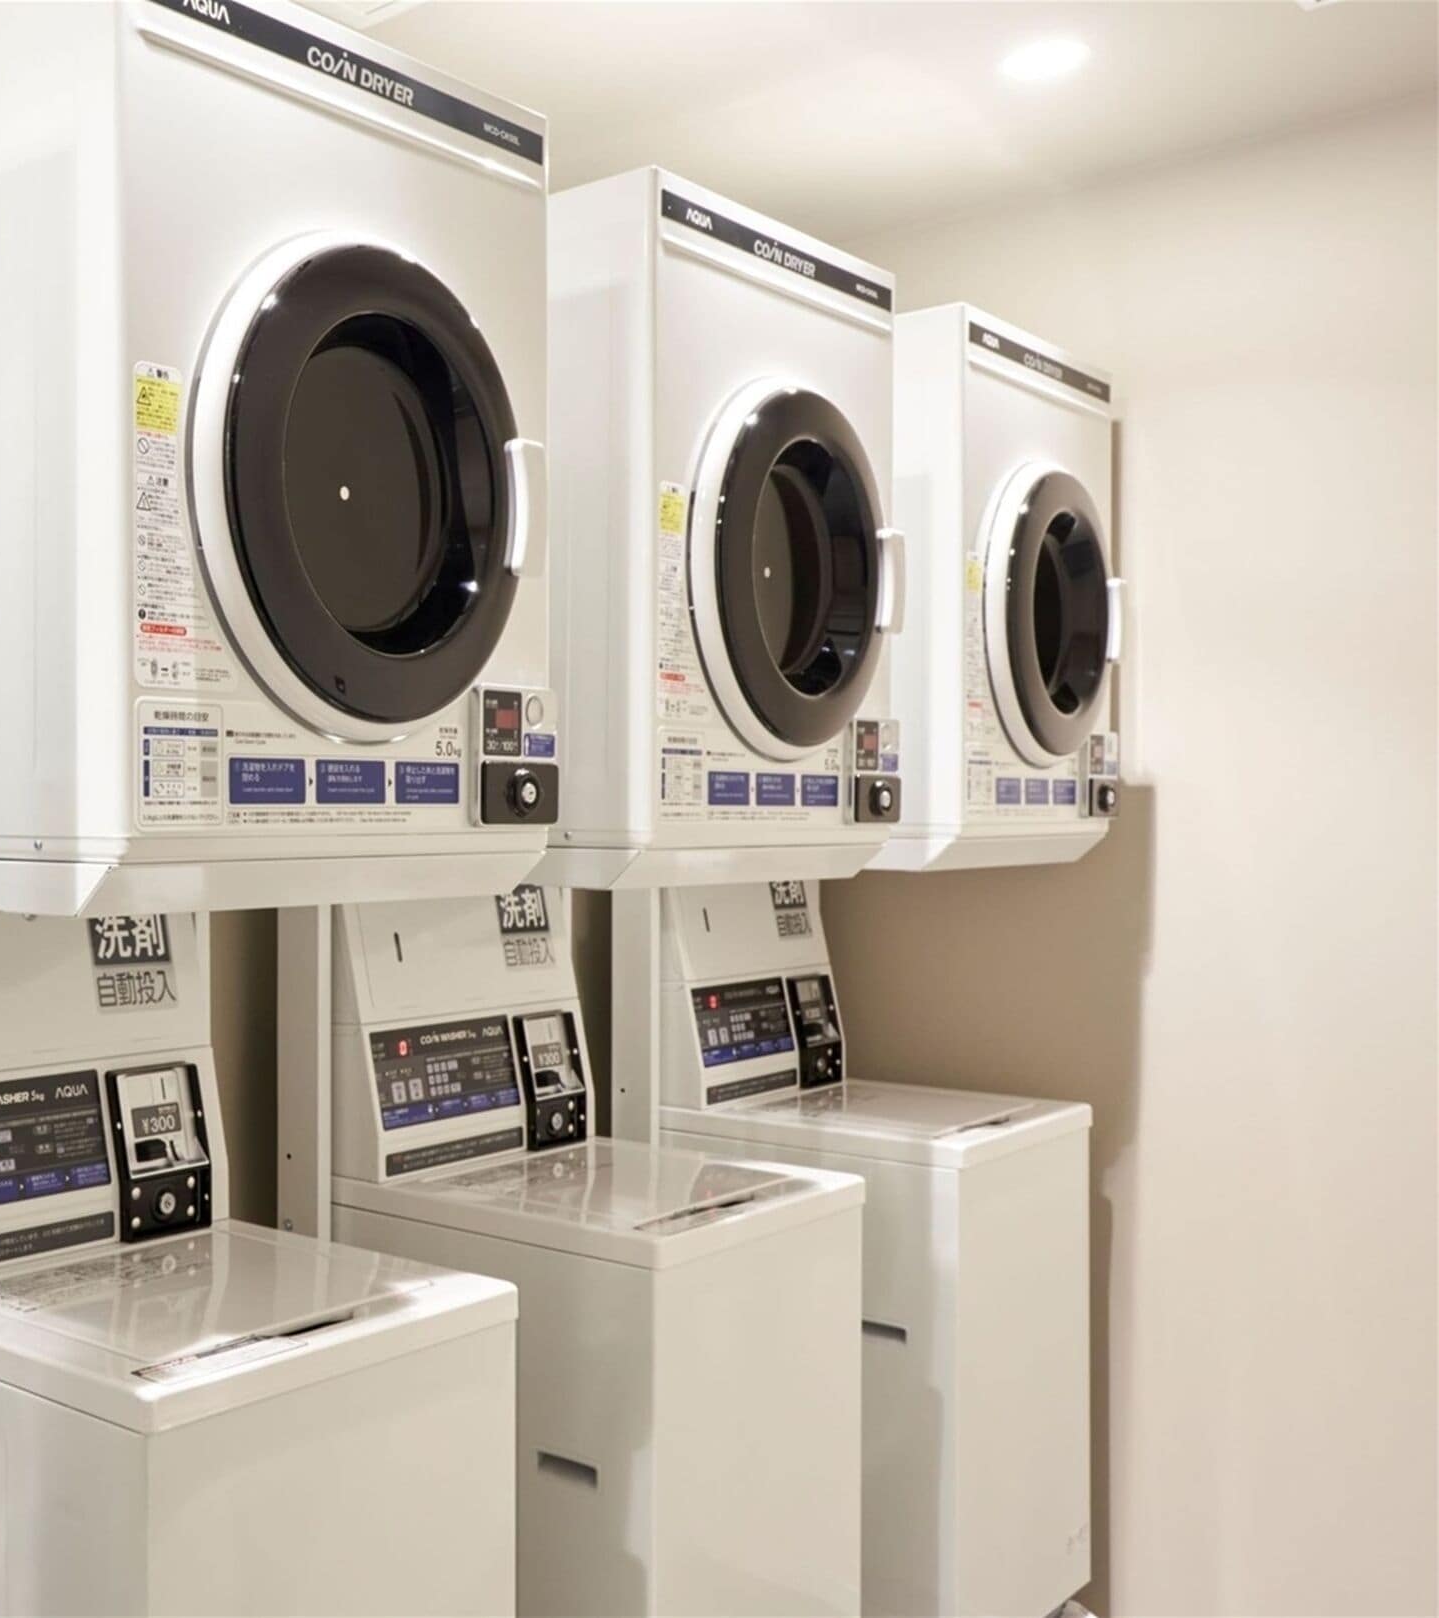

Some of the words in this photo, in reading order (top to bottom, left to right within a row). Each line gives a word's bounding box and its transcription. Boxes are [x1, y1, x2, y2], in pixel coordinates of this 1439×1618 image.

[307, 46, 358, 83] COIN
[360, 63, 414, 107] DRYER
[784, 250, 816, 279] DRYER
[500, 888, 545, 928] 洗剤
[94, 914, 166, 960] 洗剤
[504, 936, 556, 967] 自動投入
[97, 970, 177, 1008] 自動投入
[55, 1083, 89, 1100] AQUA
[142, 1115, 176, 1135] ¥300
